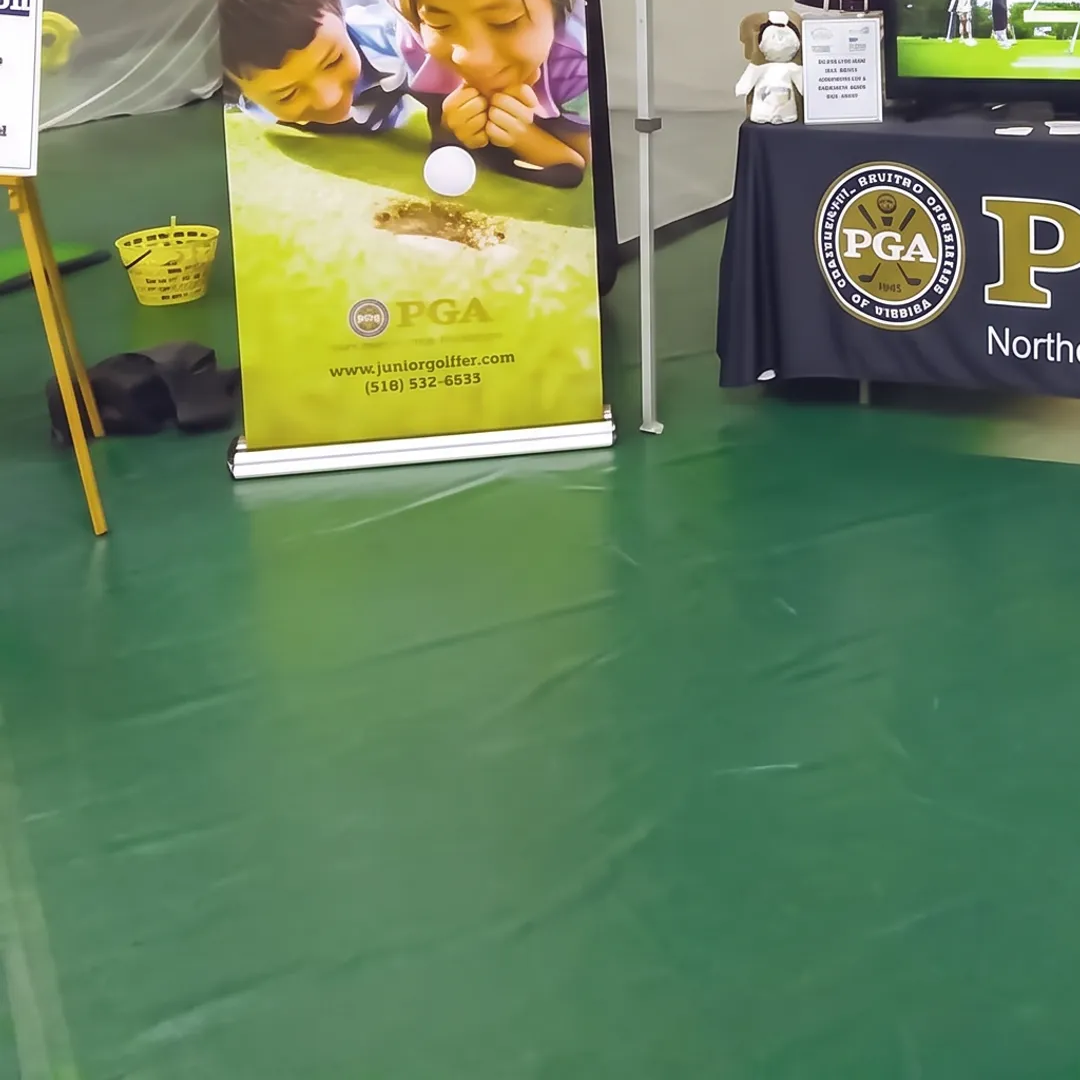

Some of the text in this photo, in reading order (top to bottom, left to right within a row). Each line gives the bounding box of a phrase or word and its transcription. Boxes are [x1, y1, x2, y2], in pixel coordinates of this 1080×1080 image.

[843, 228, 937, 264] PGA
[396, 297, 494, 328] PGA
[365, 372, 481, 396] (518) 532-6533
